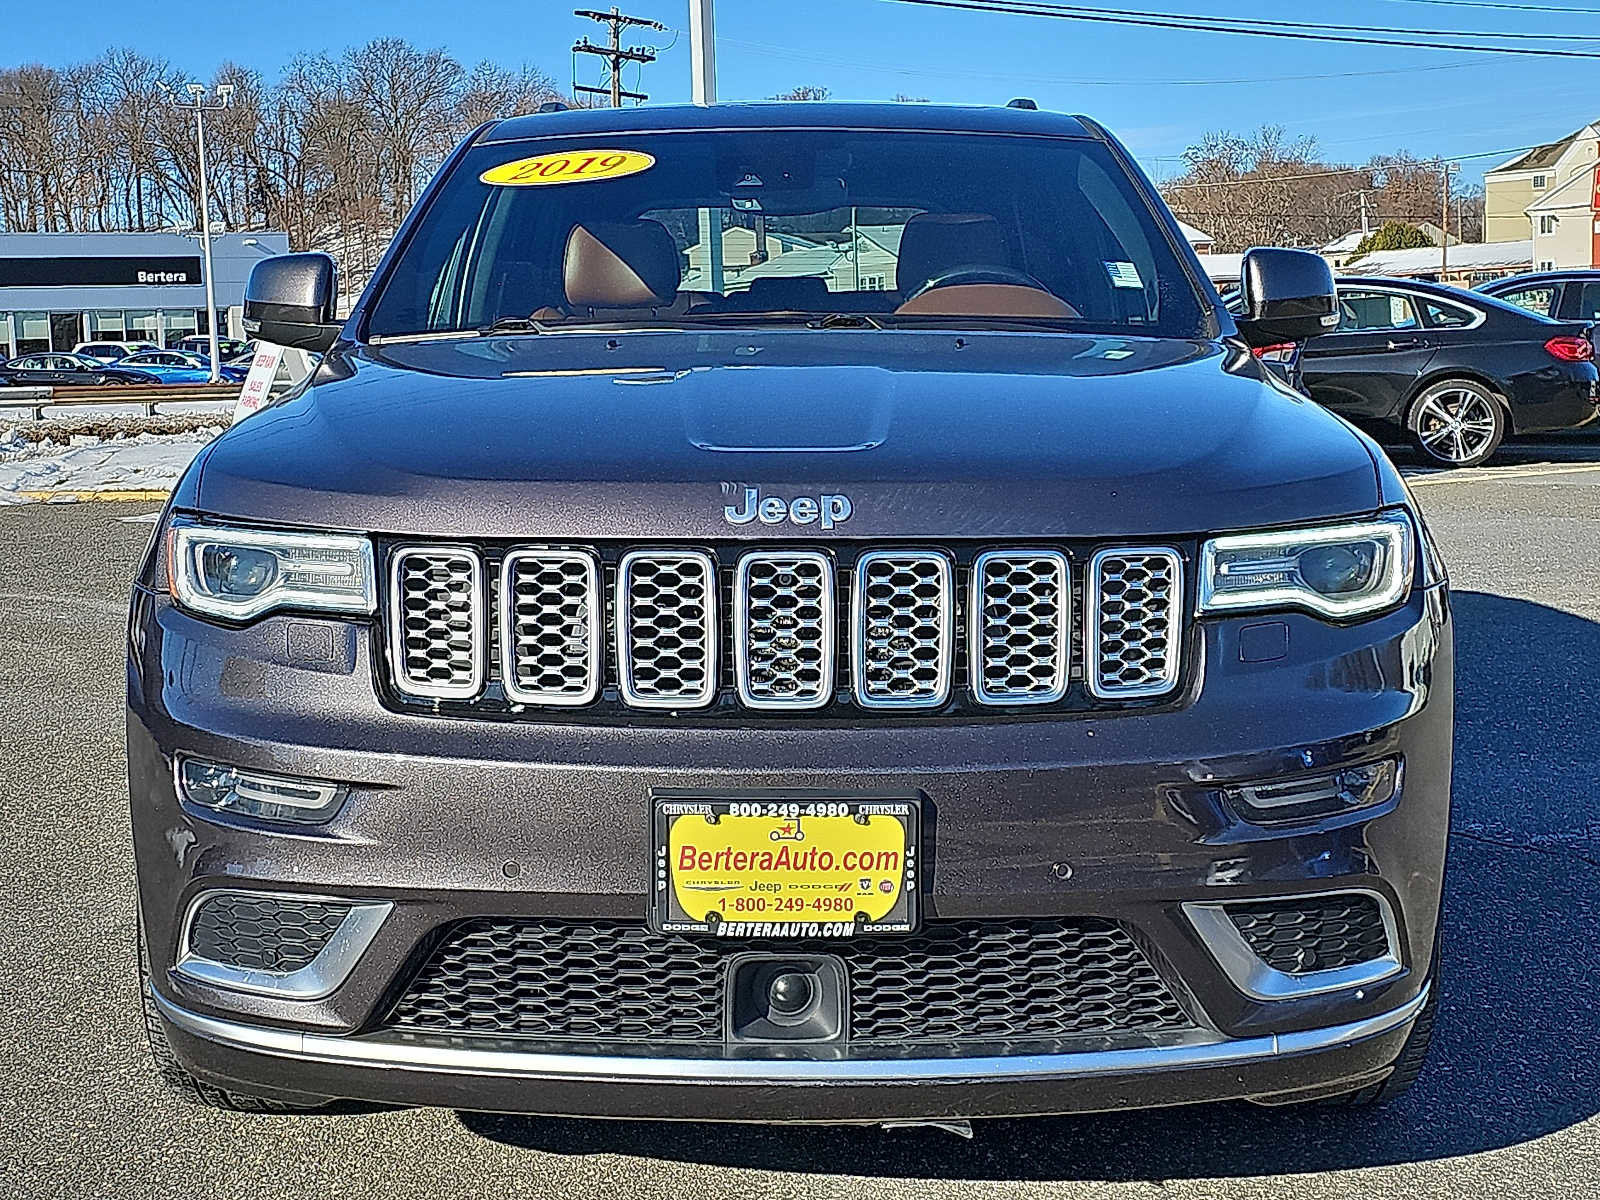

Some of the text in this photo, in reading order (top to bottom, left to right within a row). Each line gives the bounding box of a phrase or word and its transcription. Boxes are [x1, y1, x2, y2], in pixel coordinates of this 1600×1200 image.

[508, 154, 627, 181] 2019
[137, 271, 187, 282] Bertera
[724, 487, 853, 530] Jeep
[662, 803, 713, 815] CHRYSLER
[729, 803, 849, 817] 800-249-4980
[858, 804, 910, 815] CHRYSLER
[679, 845, 899, 871] BerteraAuto.com
[657, 845, 667, 891] Jeep
[905, 845, 916, 891] Jeep
[749, 881, 782, 893] Jeep
[718, 897, 854, 912] 1-800-249-4980
[662, 923, 709, 932] DODGE
[716, 922, 856, 937] BERTERAAUTO.COM
[863, 924, 910, 932] DODGE
